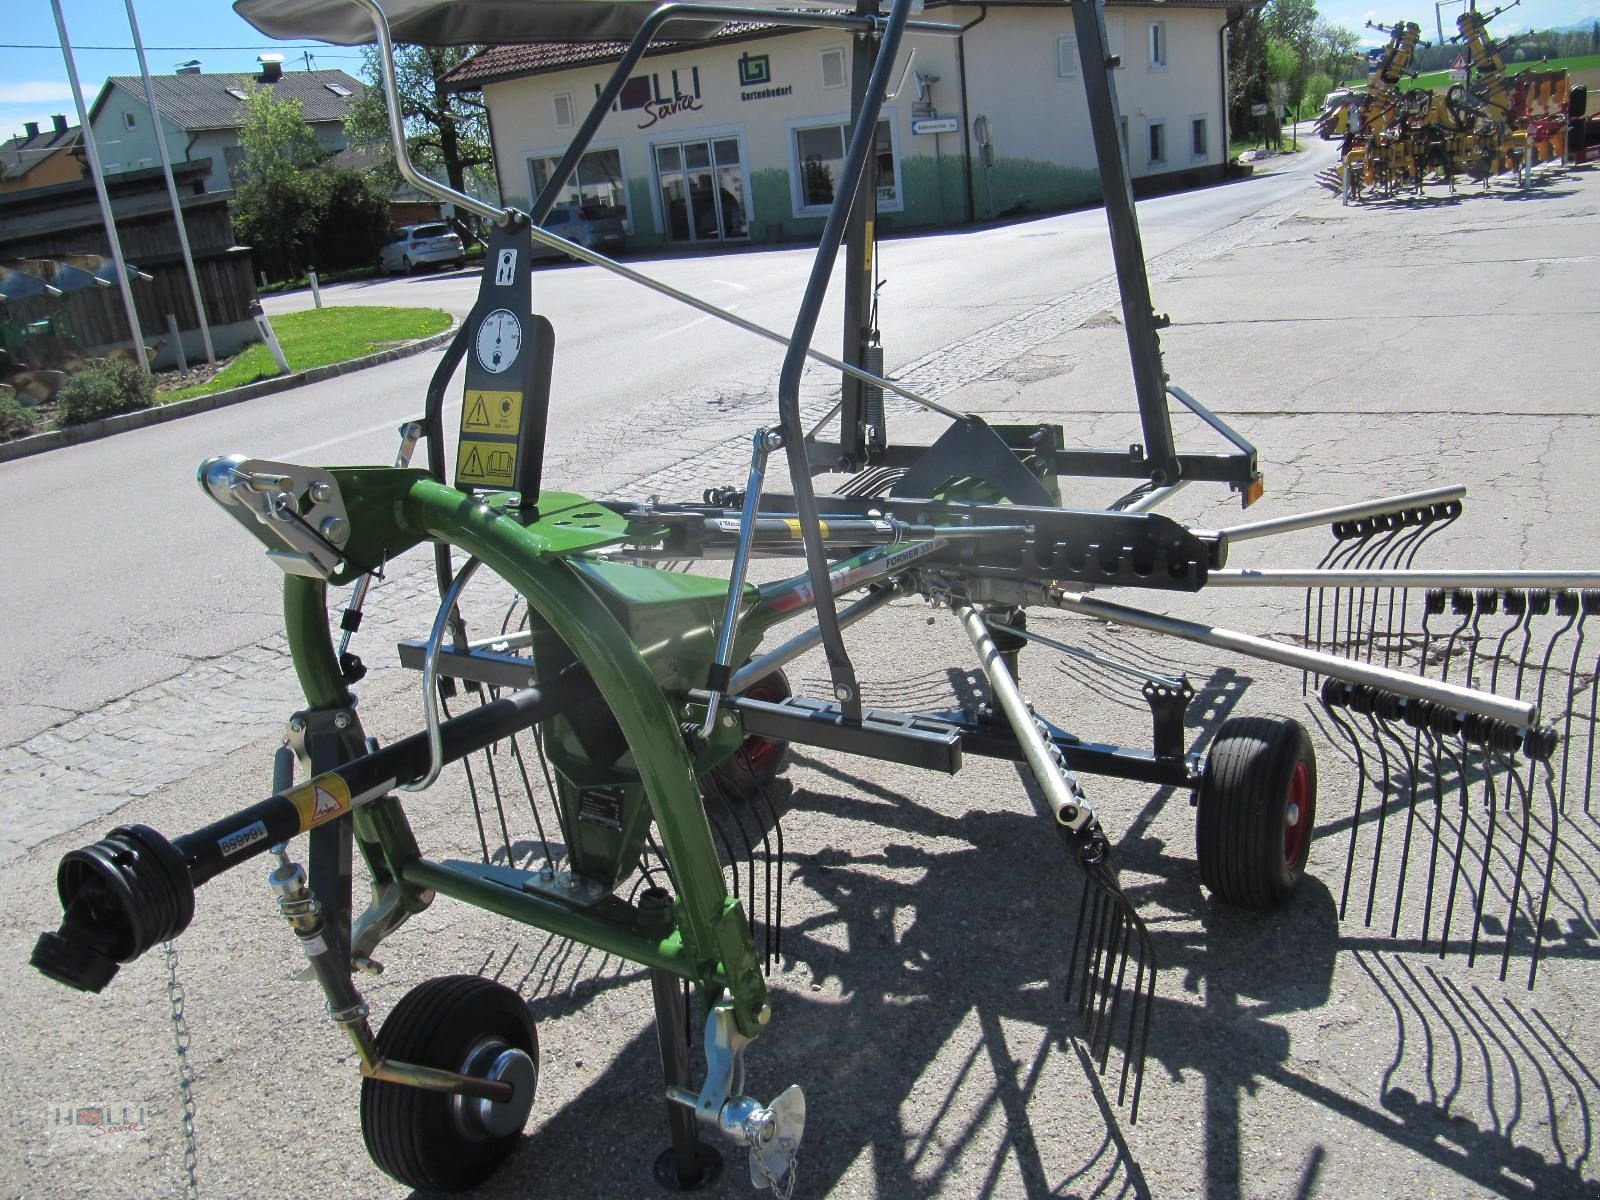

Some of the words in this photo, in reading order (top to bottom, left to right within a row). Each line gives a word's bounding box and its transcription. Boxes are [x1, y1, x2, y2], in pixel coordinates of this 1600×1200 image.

[741, 85, 792, 102] Gartenbedarf
[638, 91, 703, 129] Service
[886, 548, 919, 568] FORMER
[222, 826, 264, 853] 164659
